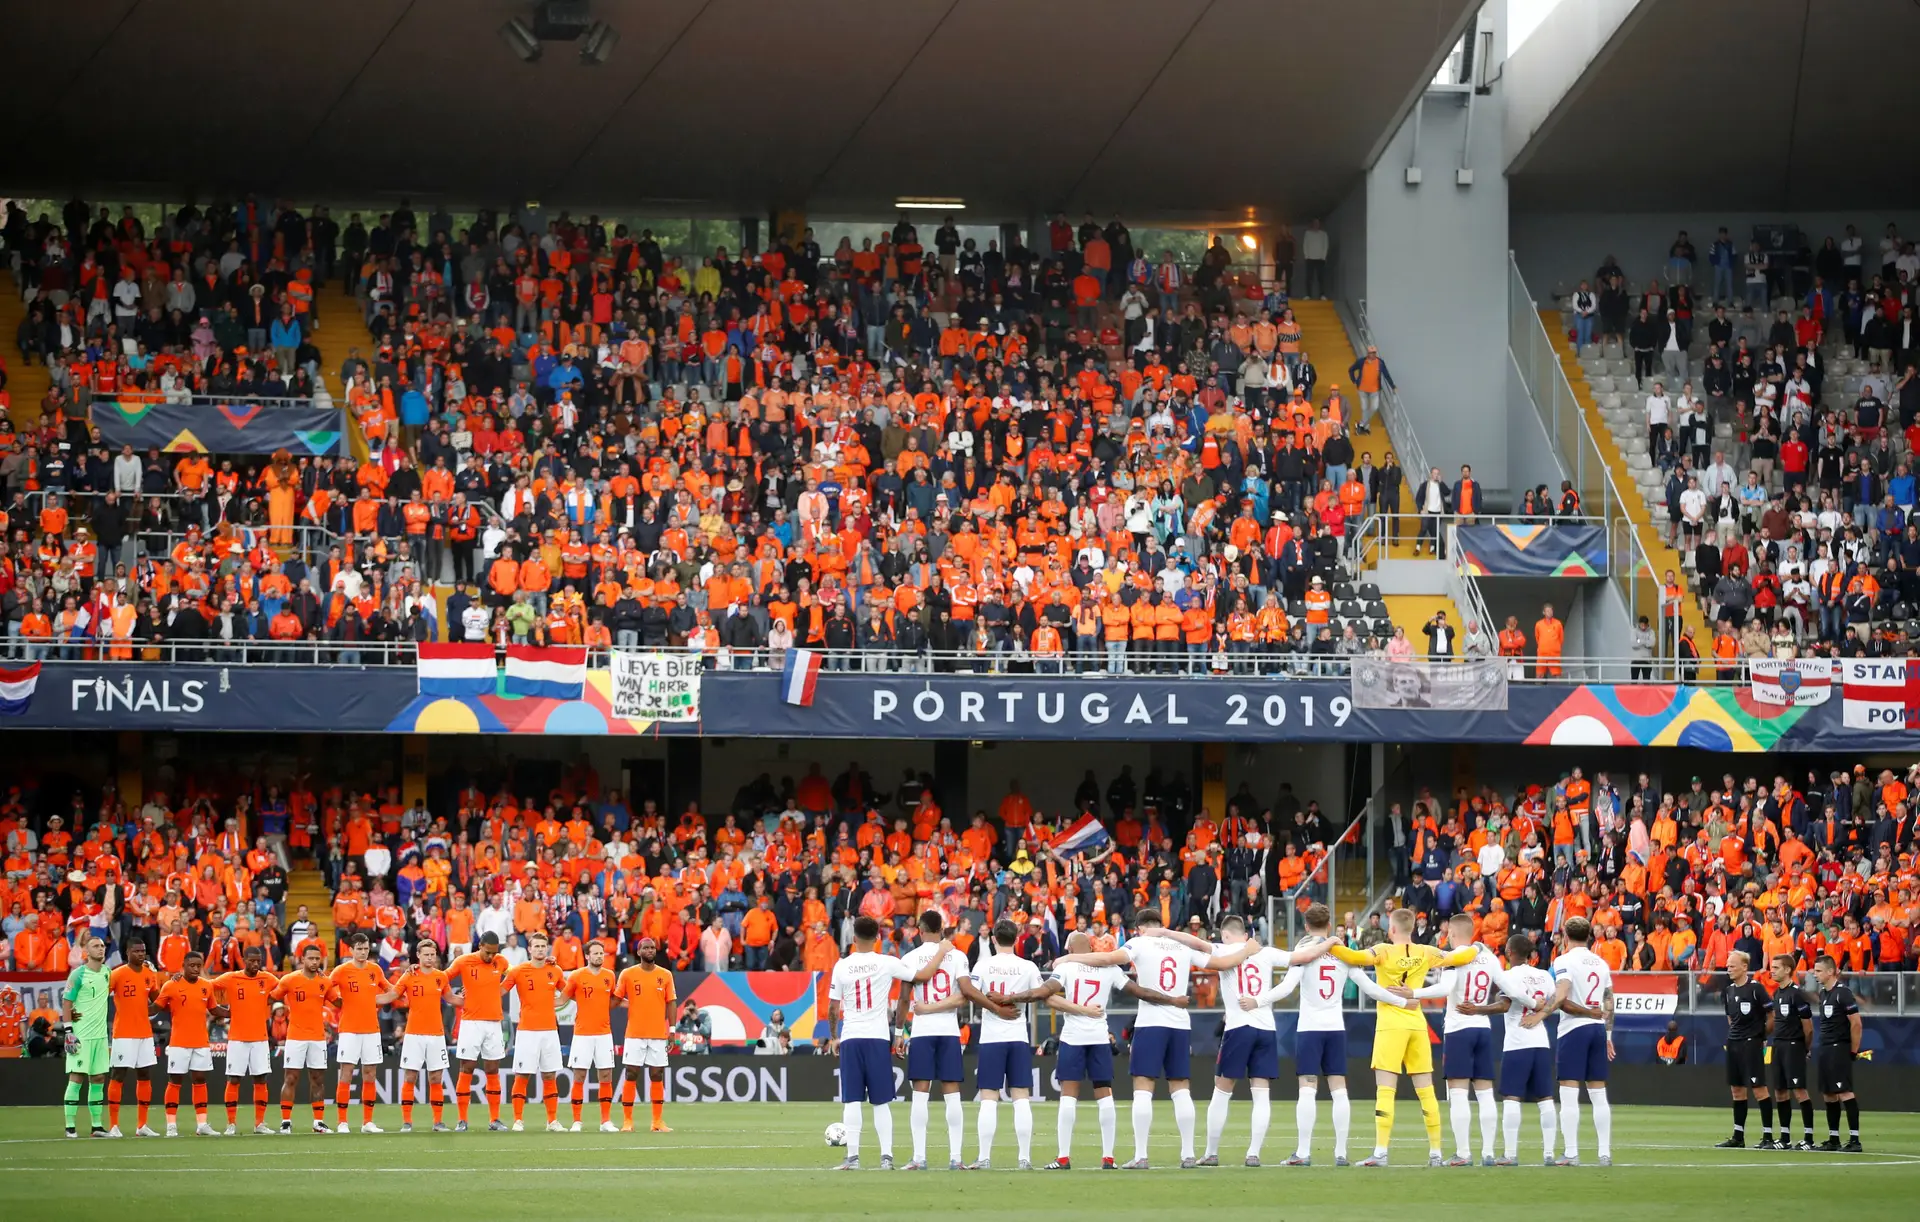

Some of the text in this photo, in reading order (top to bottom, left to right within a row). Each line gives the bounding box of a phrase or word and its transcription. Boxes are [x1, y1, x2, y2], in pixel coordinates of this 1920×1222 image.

[1813, 664, 1825, 674] FC
[1853, 663, 1920, 681] STAM
[71, 676, 204, 713] FINALS
[873, 690, 1352, 727] PORTUGAL 2019
[471, 969, 478, 980] 4
[848, 963, 878, 974] SANCHO
[1159, 956, 1177, 991] 6
[528, 980, 534, 991] 3
[922, 968, 951, 1005] 19
[1236, 963, 1262, 997] 16
[1319, 965, 1336, 1000] 5
[123, 985, 136, 998] 22
[348, 981, 359, 993] 15
[412, 986, 424, 997] 21
[634, 984, 641, 996] 9
[1073, 978, 1101, 1007] 17
[1463, 970, 1490, 1005] 18
[1585, 971, 1600, 1006] 2
[180, 994, 187, 1006] 7
[237, 988, 245, 1000] 8
[295, 991, 306, 1002] 10
[854, 977, 873, 1013] 11
[1615, 997, 1665, 1010] EESCH
